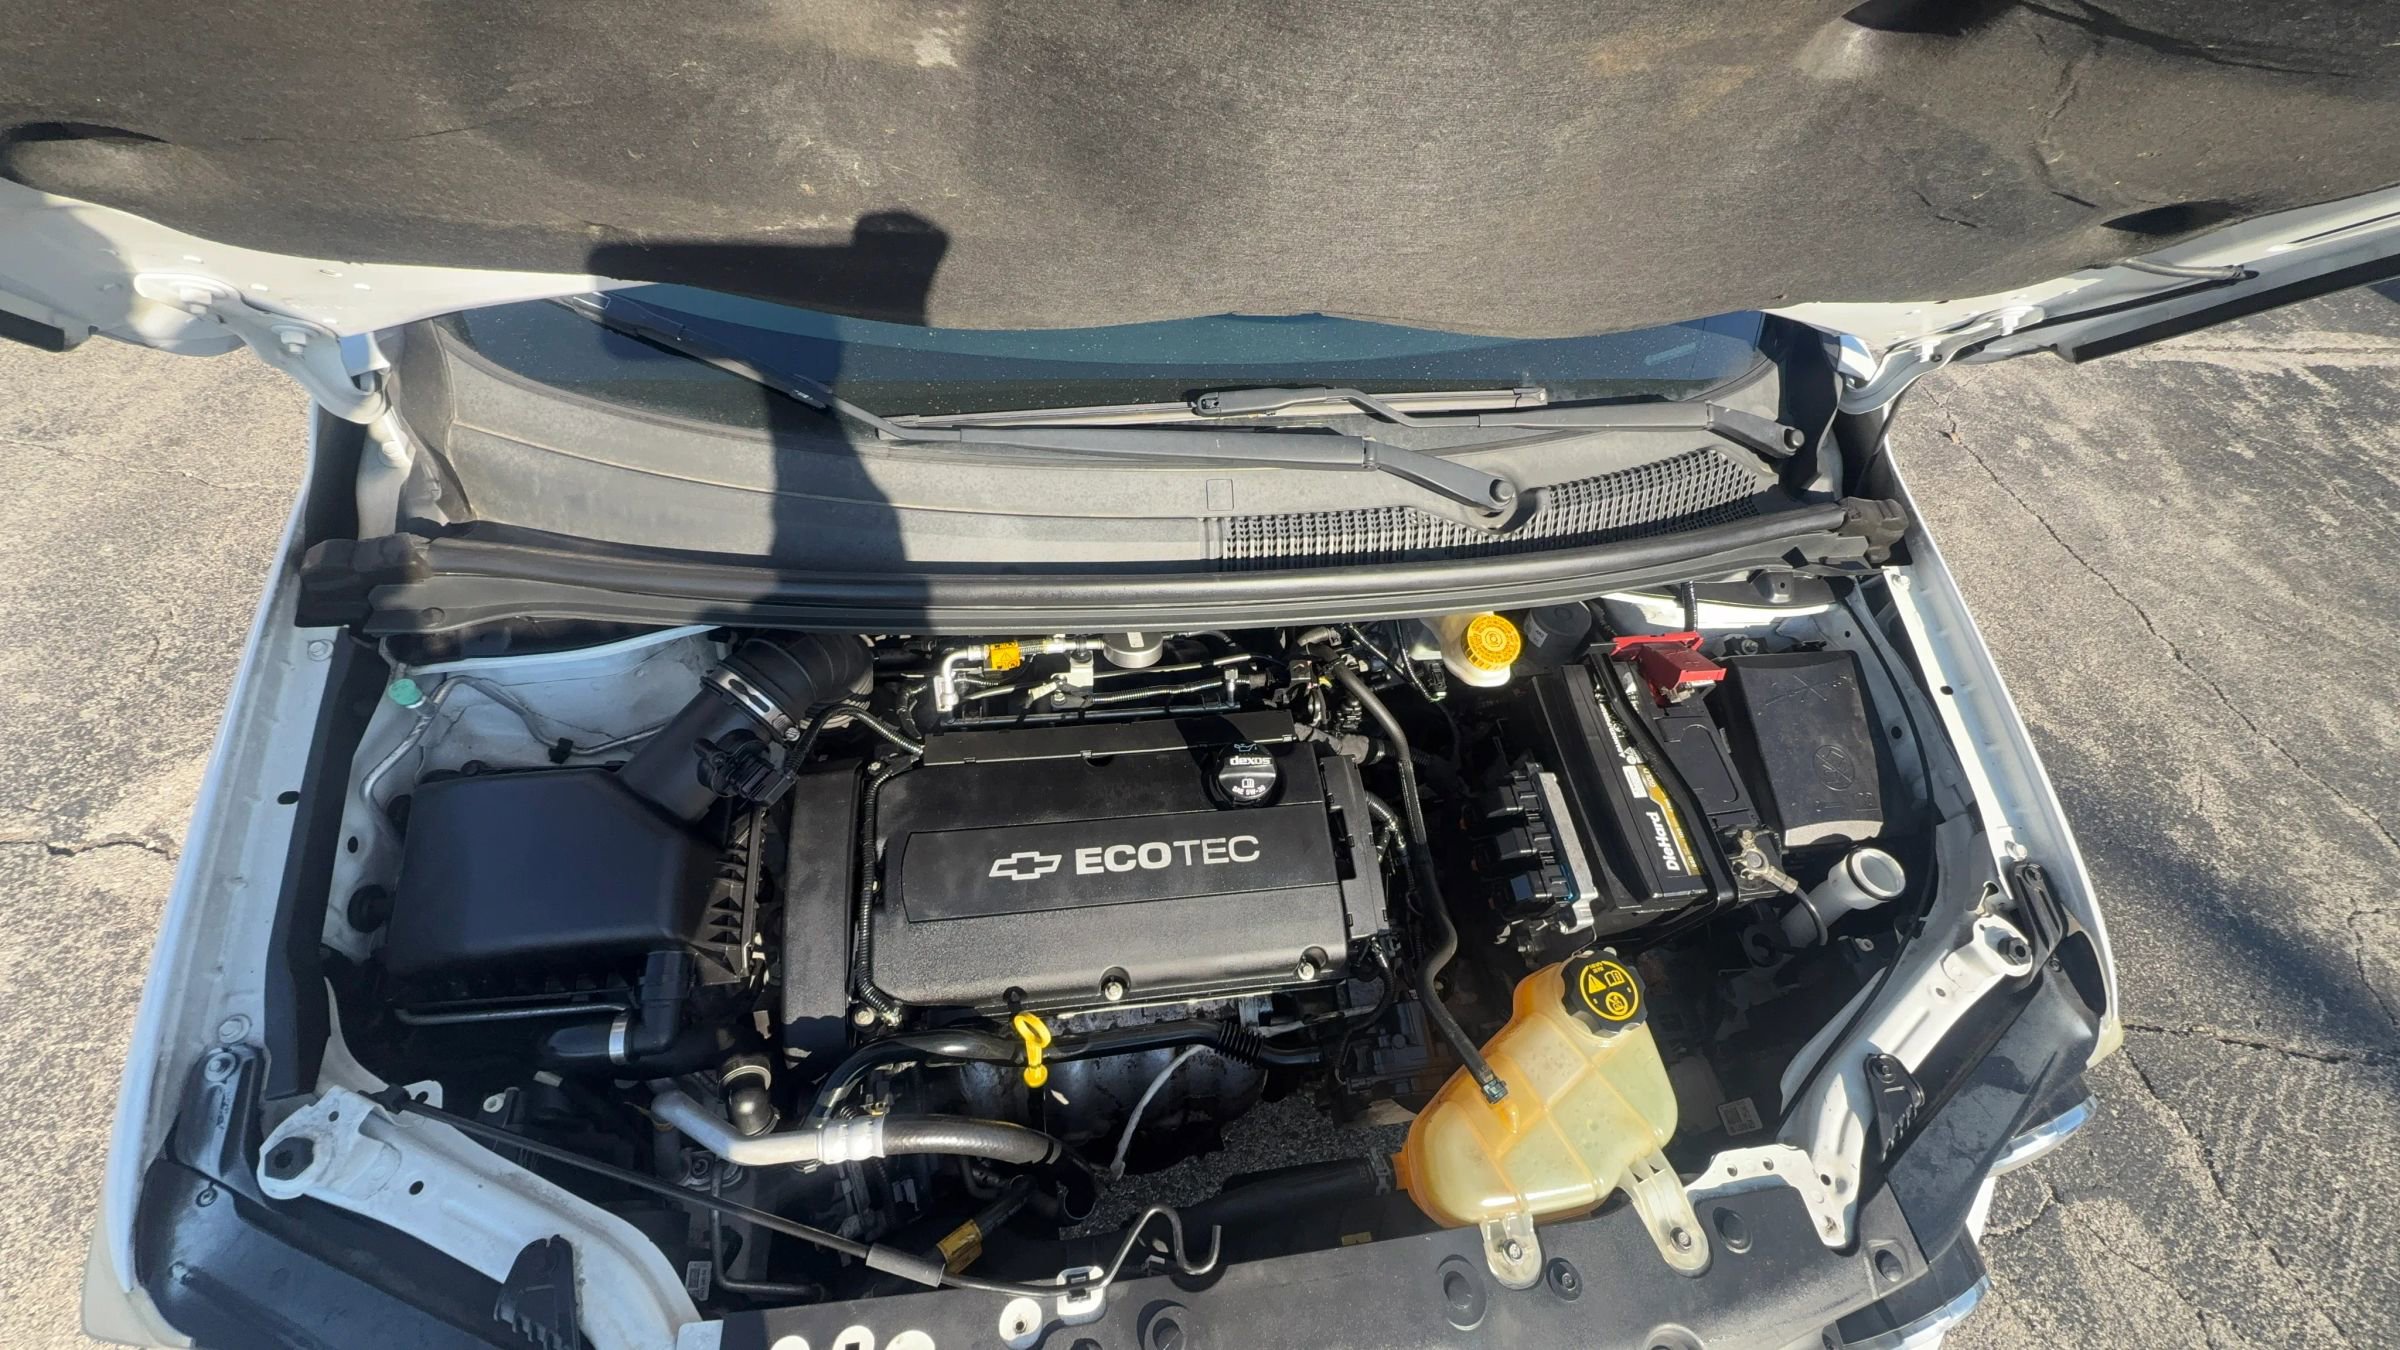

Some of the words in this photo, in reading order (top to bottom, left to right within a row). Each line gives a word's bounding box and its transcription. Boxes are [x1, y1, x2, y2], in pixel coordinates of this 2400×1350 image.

[1230, 755, 1272, 766] dexos
[1075, 835, 1261, 875] ECOTEC
[1645, 810, 1681, 871] DieHard
